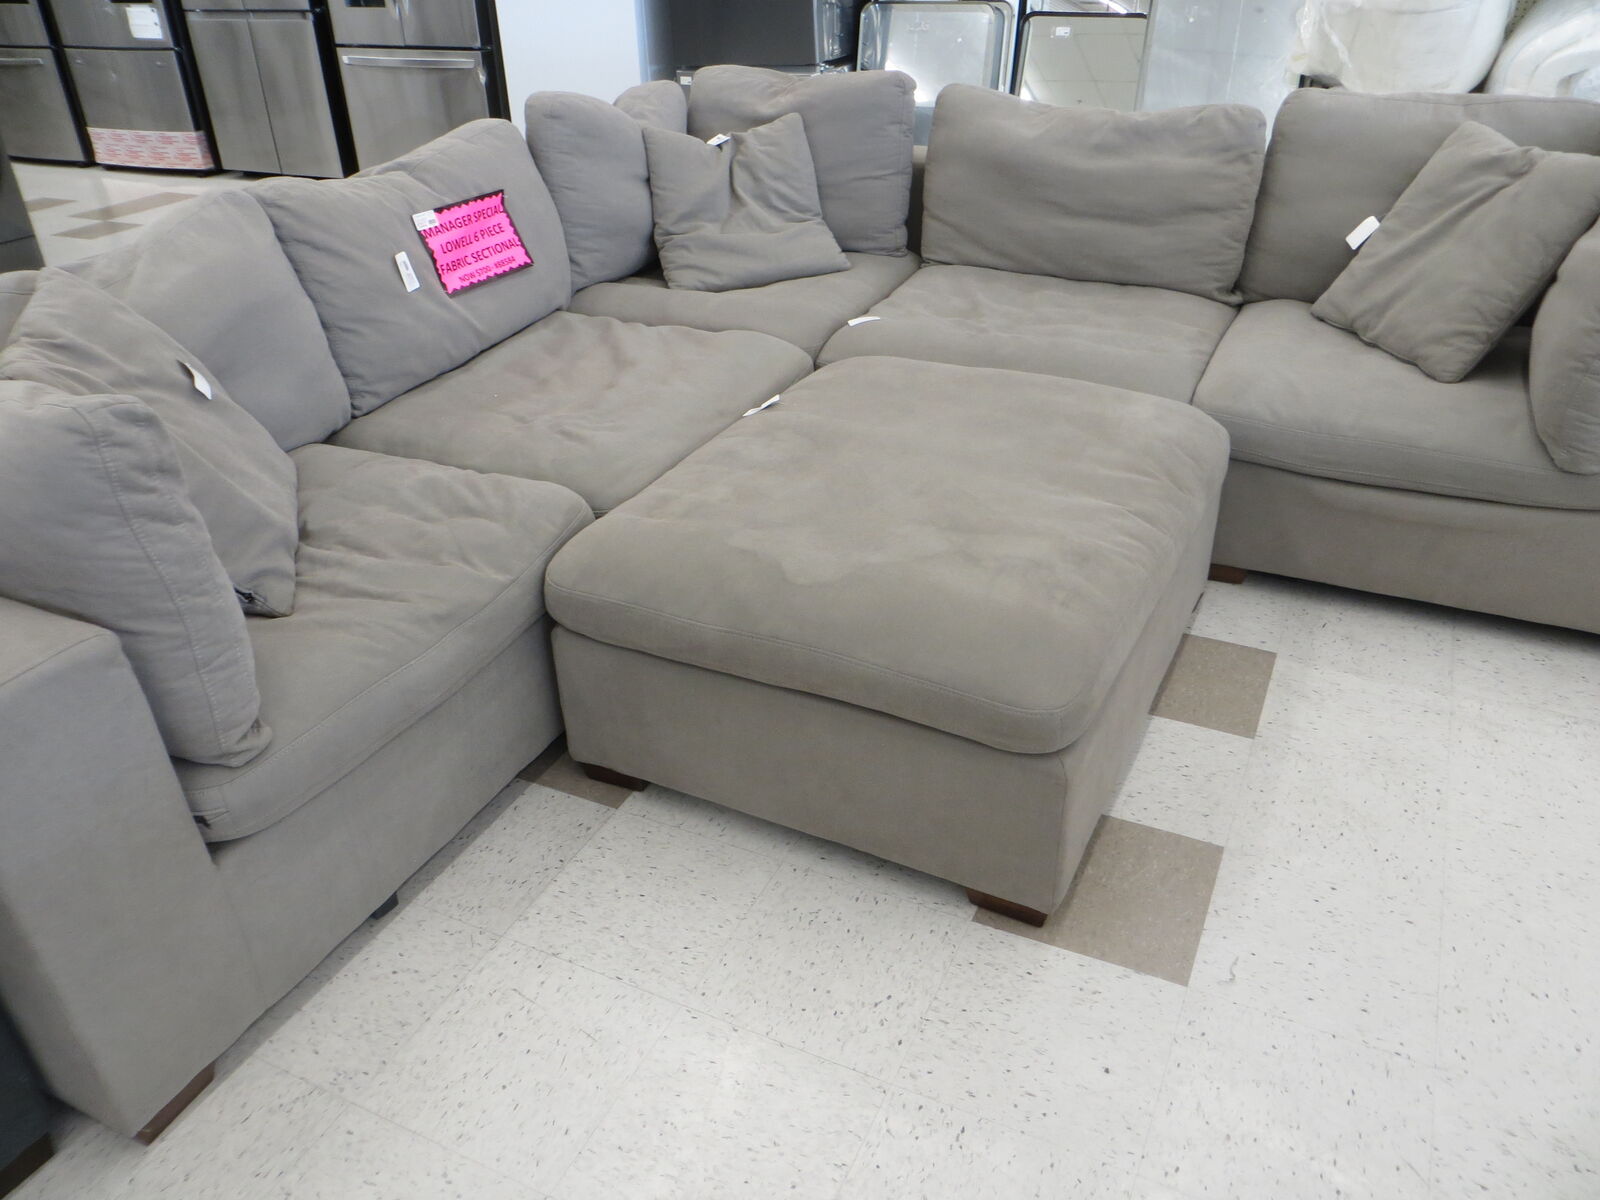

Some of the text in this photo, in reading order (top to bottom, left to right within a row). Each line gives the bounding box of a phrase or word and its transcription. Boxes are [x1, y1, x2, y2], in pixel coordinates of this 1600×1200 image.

[423, 214, 473, 239] MANAGER
[474, 204, 504, 222] SPECIAL
[440, 223, 505, 253] LOWELL 6 PIECE
[440, 253, 471, 275] FABRIC
[471, 238, 520, 262] SECTIONAL
